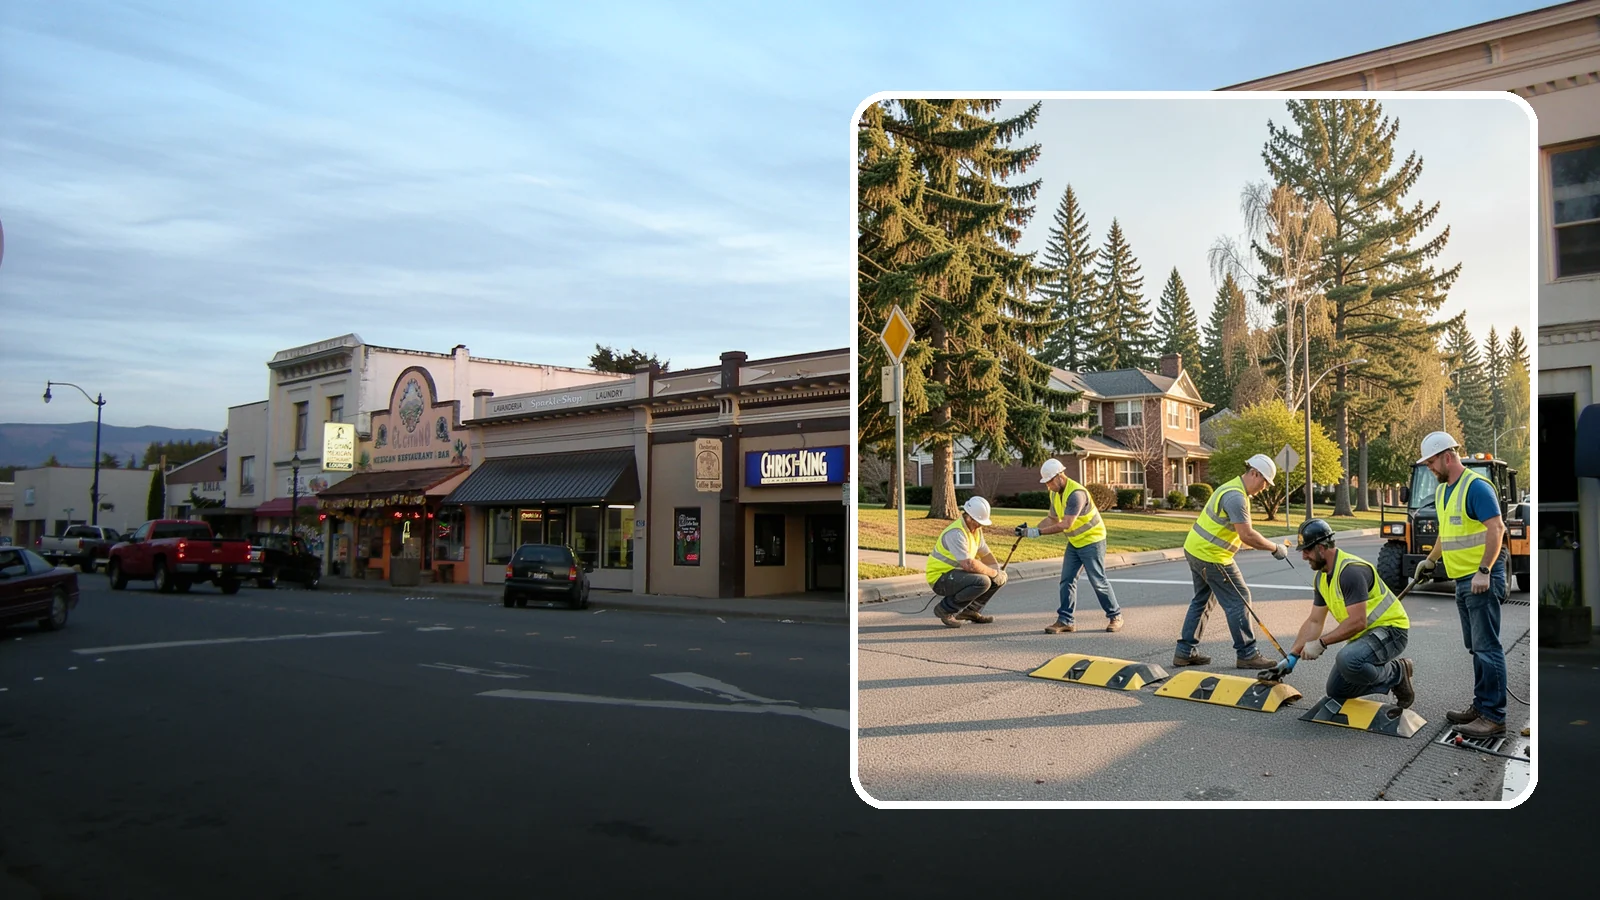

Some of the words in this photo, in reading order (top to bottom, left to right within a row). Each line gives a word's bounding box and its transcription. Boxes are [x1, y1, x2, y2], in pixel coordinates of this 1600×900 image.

[596, 389, 623, 400] LAUNDRY
[494, 402, 522, 412] LAVANDERIA
[531, 396, 561, 408] Sparkle
[562, 394, 582, 404] Shop
[398, 451, 433, 462] RESTAURANT
[438, 450, 450, 458] BAR
[761, 452, 797, 477] CHRIST
[799, 450, 827, 476] KING
